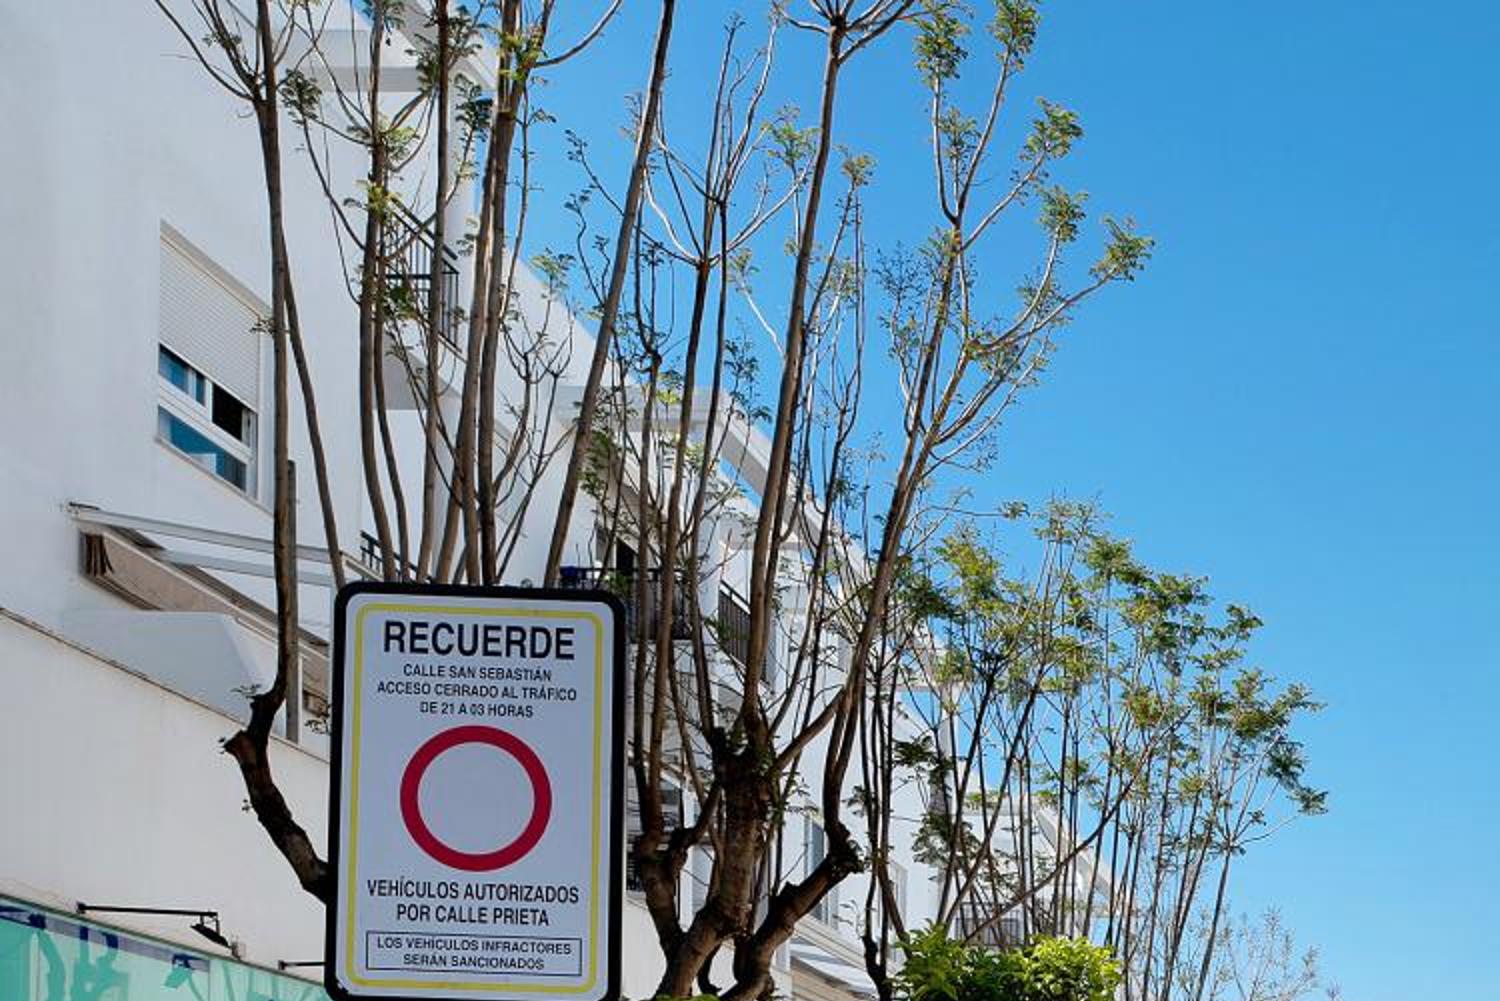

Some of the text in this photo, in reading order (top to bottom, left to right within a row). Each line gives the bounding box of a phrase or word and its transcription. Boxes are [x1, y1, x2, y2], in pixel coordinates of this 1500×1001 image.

[383, 621, 574, 660] RECUERDE
[404, 663, 553, 681] CALLE SAN SEBASTIÁN
[377, 681, 577, 701] ACCESO CERRADO AL TRÁFICO
[420, 701, 534, 718] DE 21 A 03 HORAS
[367, 876, 580, 903] VEHÍCULOS AUTORIZADOS
[396, 902, 550, 926] POR CALLE PRIETA
[377, 934, 572, 955] LOS VEHÍCULOS INFRACTORES
[403, 952, 545, 970] SERÁN SANCIONADOS
